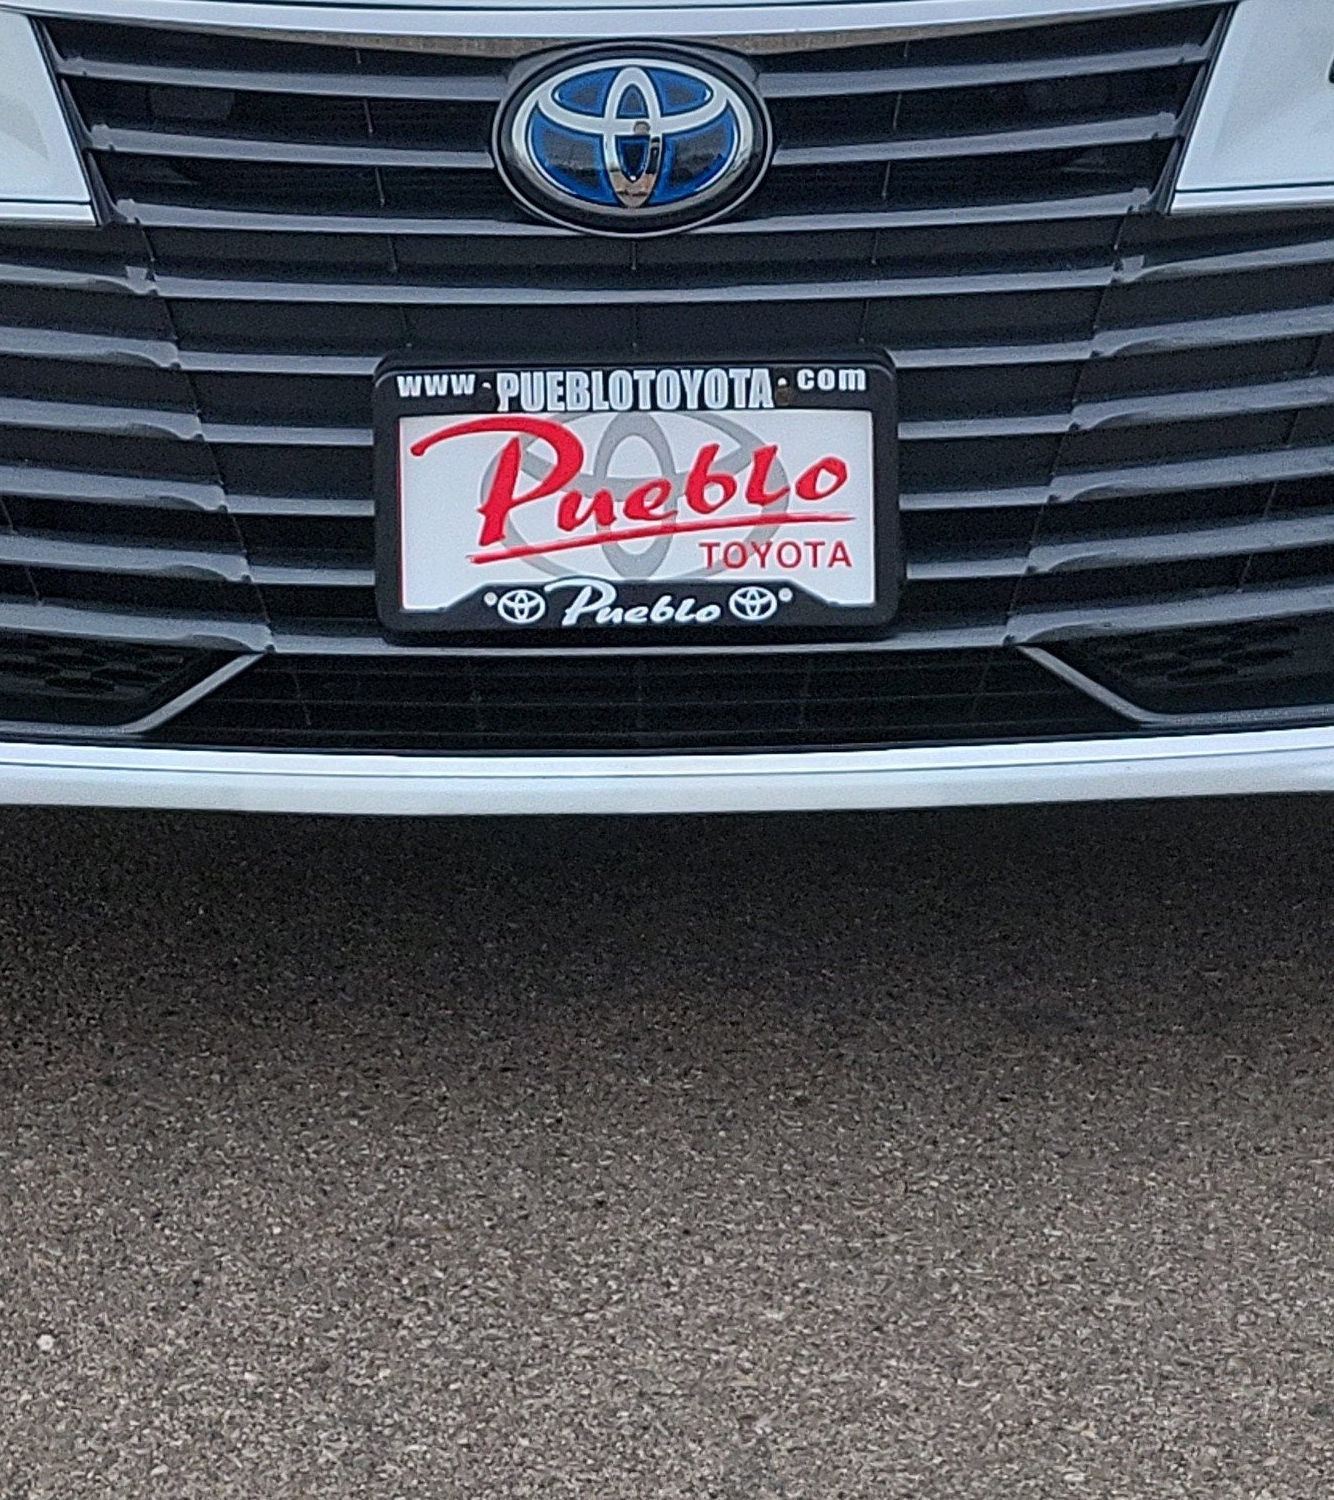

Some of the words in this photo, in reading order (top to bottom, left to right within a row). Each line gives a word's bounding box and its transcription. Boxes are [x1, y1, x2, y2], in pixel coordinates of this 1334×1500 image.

[410, 416, 848, 546] Pueblo
[698, 541, 853, 569] TOYOTA
[543, 576, 722, 626] Pueblo
